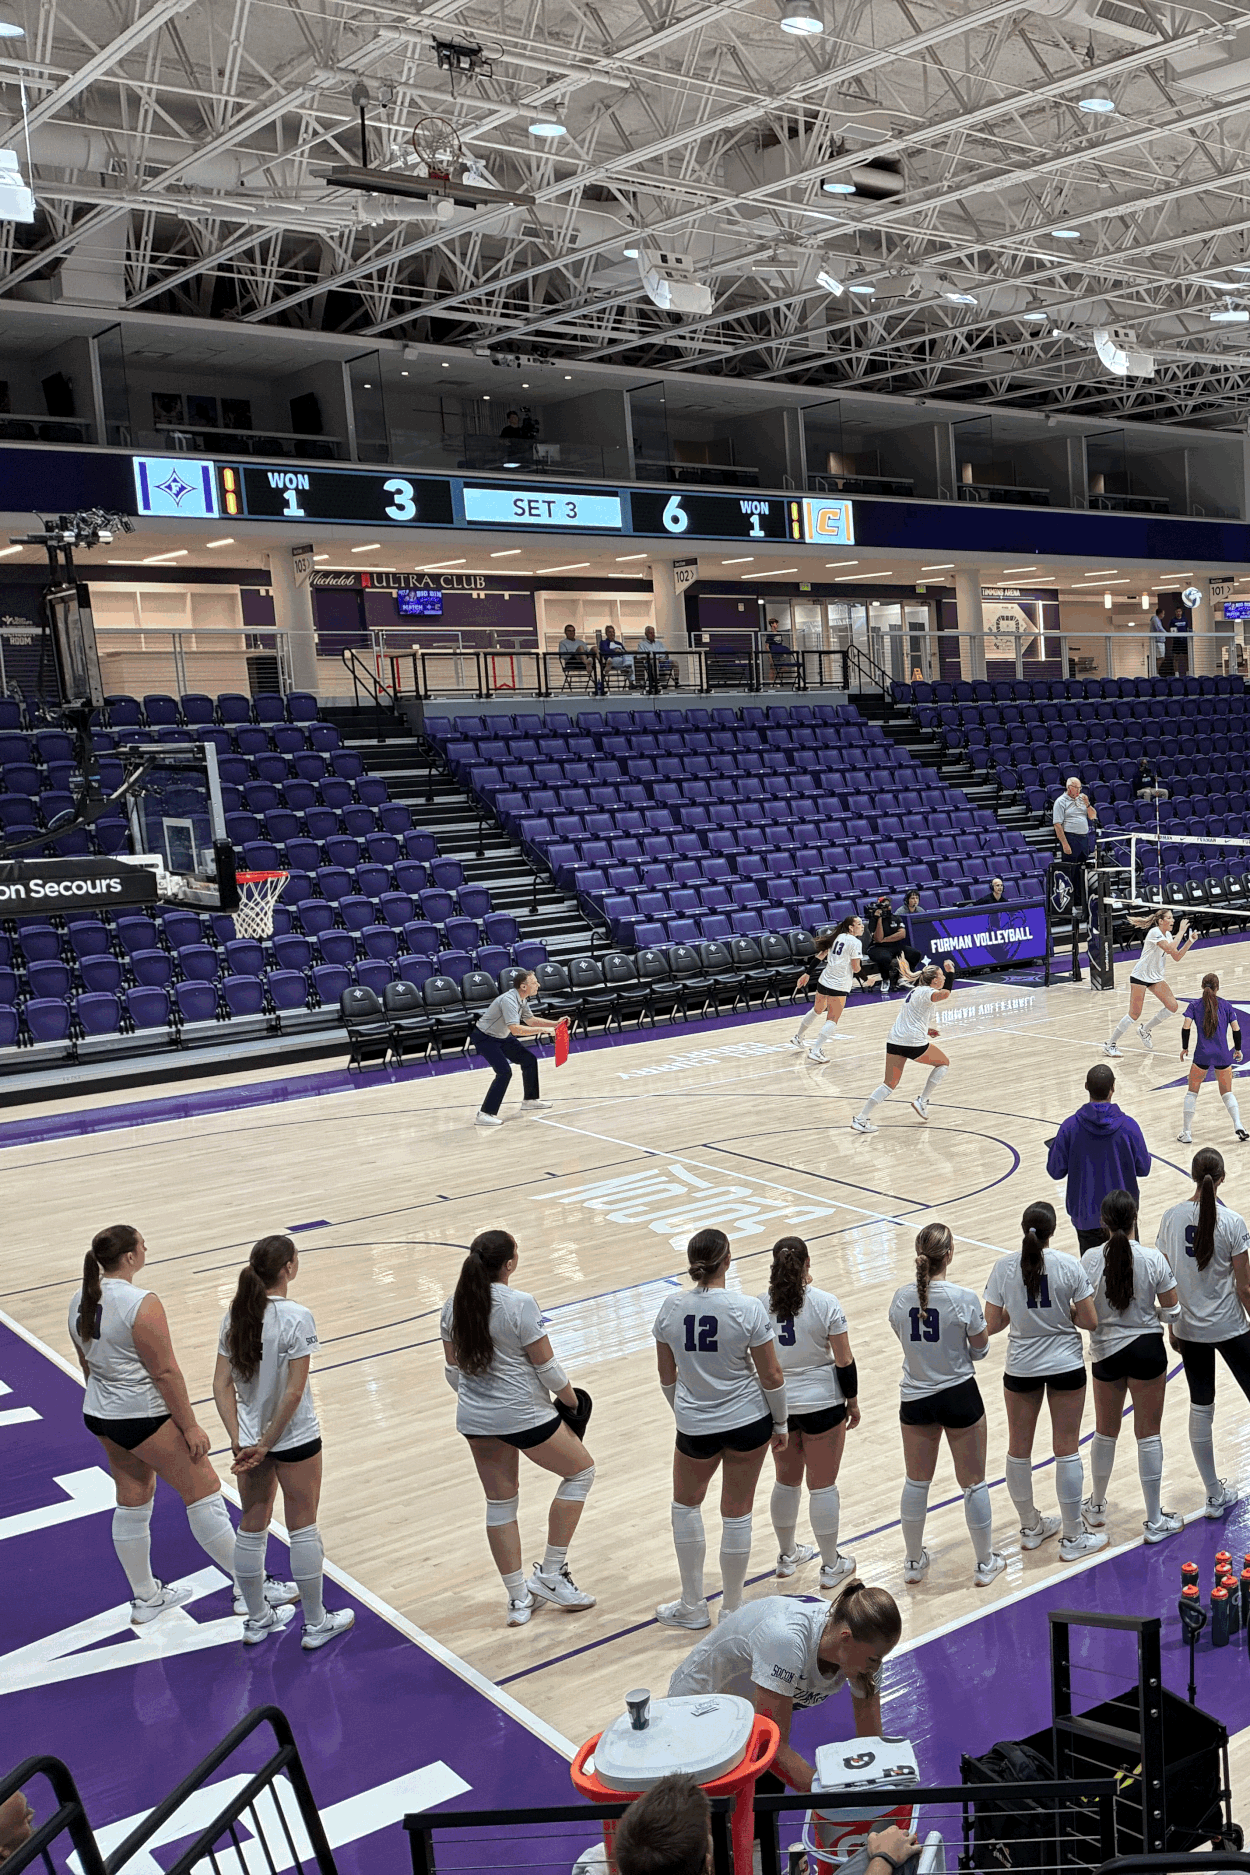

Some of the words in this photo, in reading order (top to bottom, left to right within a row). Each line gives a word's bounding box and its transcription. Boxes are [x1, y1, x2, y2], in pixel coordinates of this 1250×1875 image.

[267, 472, 310, 490] WON
[283, 490, 305, 516] 1
[383, 479, 416, 520] 3
[513, 498, 555, 519] SET
[565, 501, 578, 520] 3
[740, 500, 769, 515] WON
[662, 495, 688, 533] 6
[749, 515, 765, 537] 1
[295, 558, 306, 574] 103
[676, 569, 690, 583] 102
[373, 573, 434, 588] ULTRA
[440, 575, 486, 589] CLUB
[1211, 586, 1224, 596] 101
[1004, 588, 1021, 597] ARENA
[29, 878, 122, 899] Secours
[832, 939, 845, 956] 13
[930, 934, 973, 953] FURMAN
[973, 926, 1033, 947] VOLLEYBALL
[664, 1041, 767, 1063] COURT
[683, 1314, 719, 1352] 12
[909, 1307, 941, 1343] 19
[770, 1663, 795, 1684] SOCON
